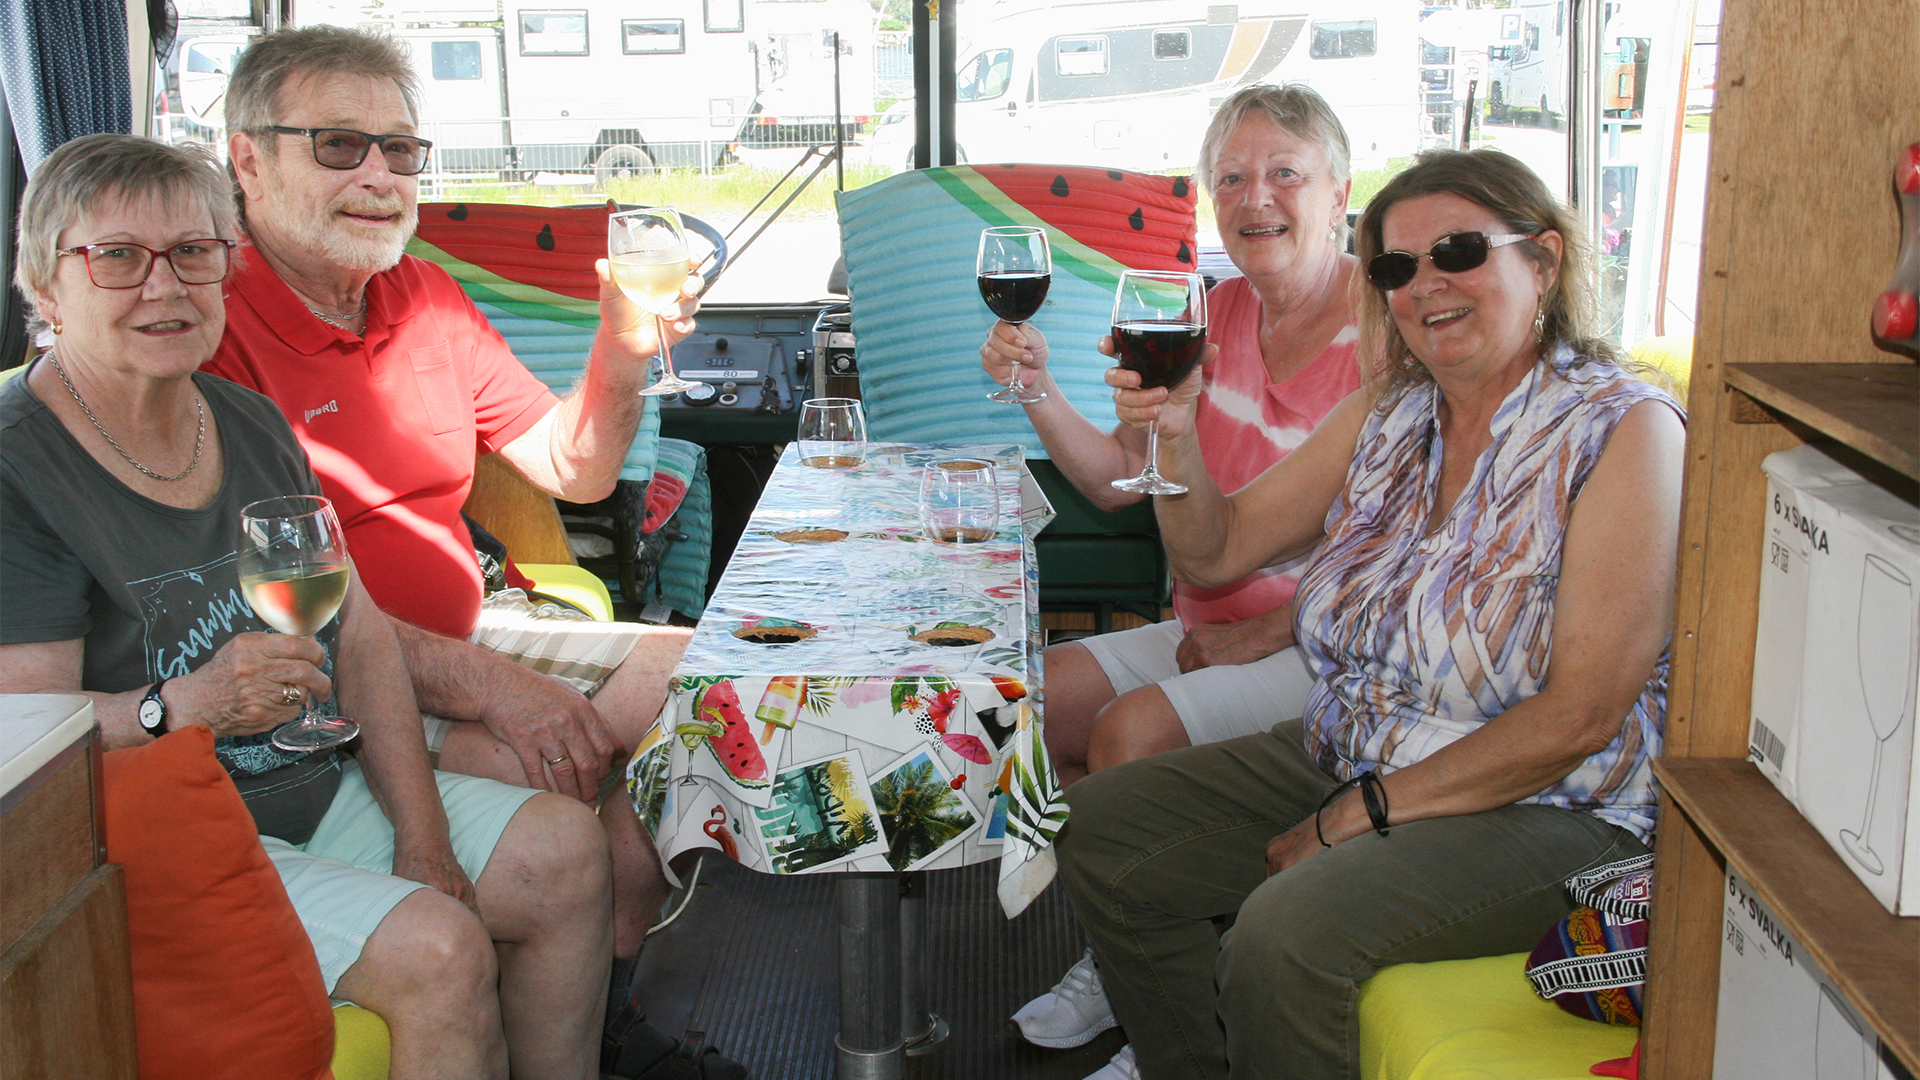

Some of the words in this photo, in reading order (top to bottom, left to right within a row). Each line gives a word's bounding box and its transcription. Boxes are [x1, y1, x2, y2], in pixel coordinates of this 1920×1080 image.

[1502, 15, 1520, 39] P
[723, 370, 738, 378] 80
[1774, 492, 1781, 515] 6
[1729, 874, 1736, 897] 6
[1748, 897, 1793, 967] SVALKA
